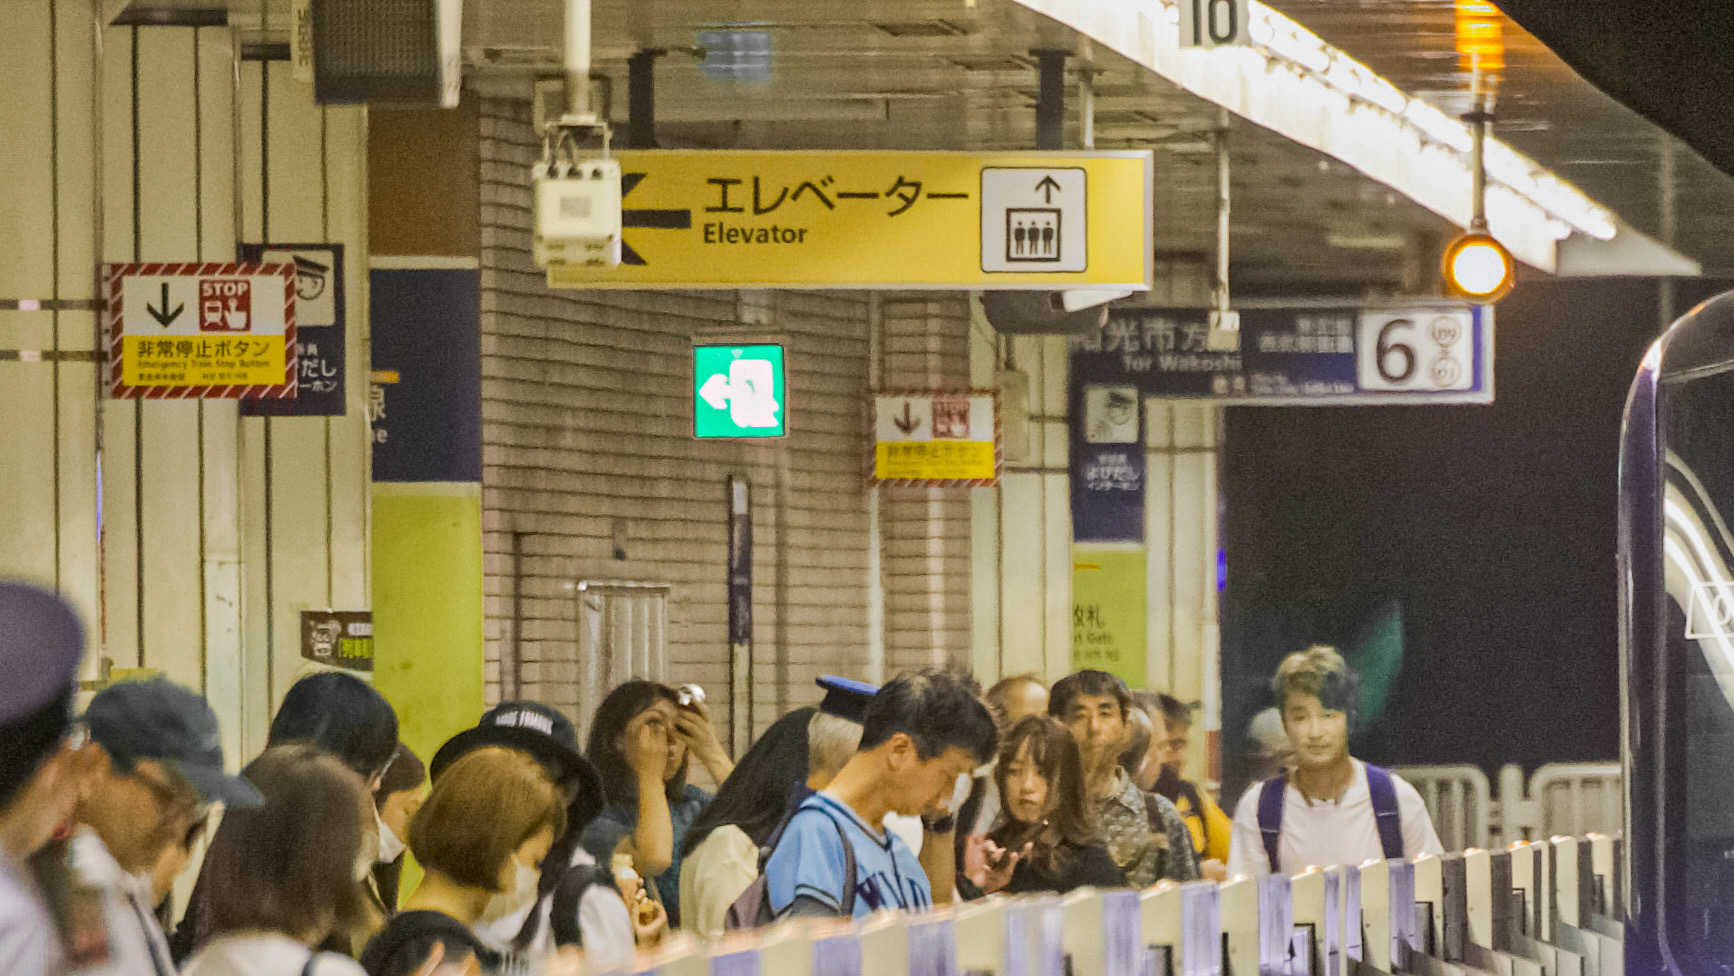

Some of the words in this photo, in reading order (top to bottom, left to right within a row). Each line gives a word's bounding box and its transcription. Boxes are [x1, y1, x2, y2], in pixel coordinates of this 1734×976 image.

[1192, 0, 1238, 45] 10
[705, 175, 969, 218] エレベーター
[703, 222, 808, 245] Elevator
[202, 284, 249, 297] STOP
[137, 340, 270, 358] 非常停止ボタン
[1376, 318, 1416, 383] 6
